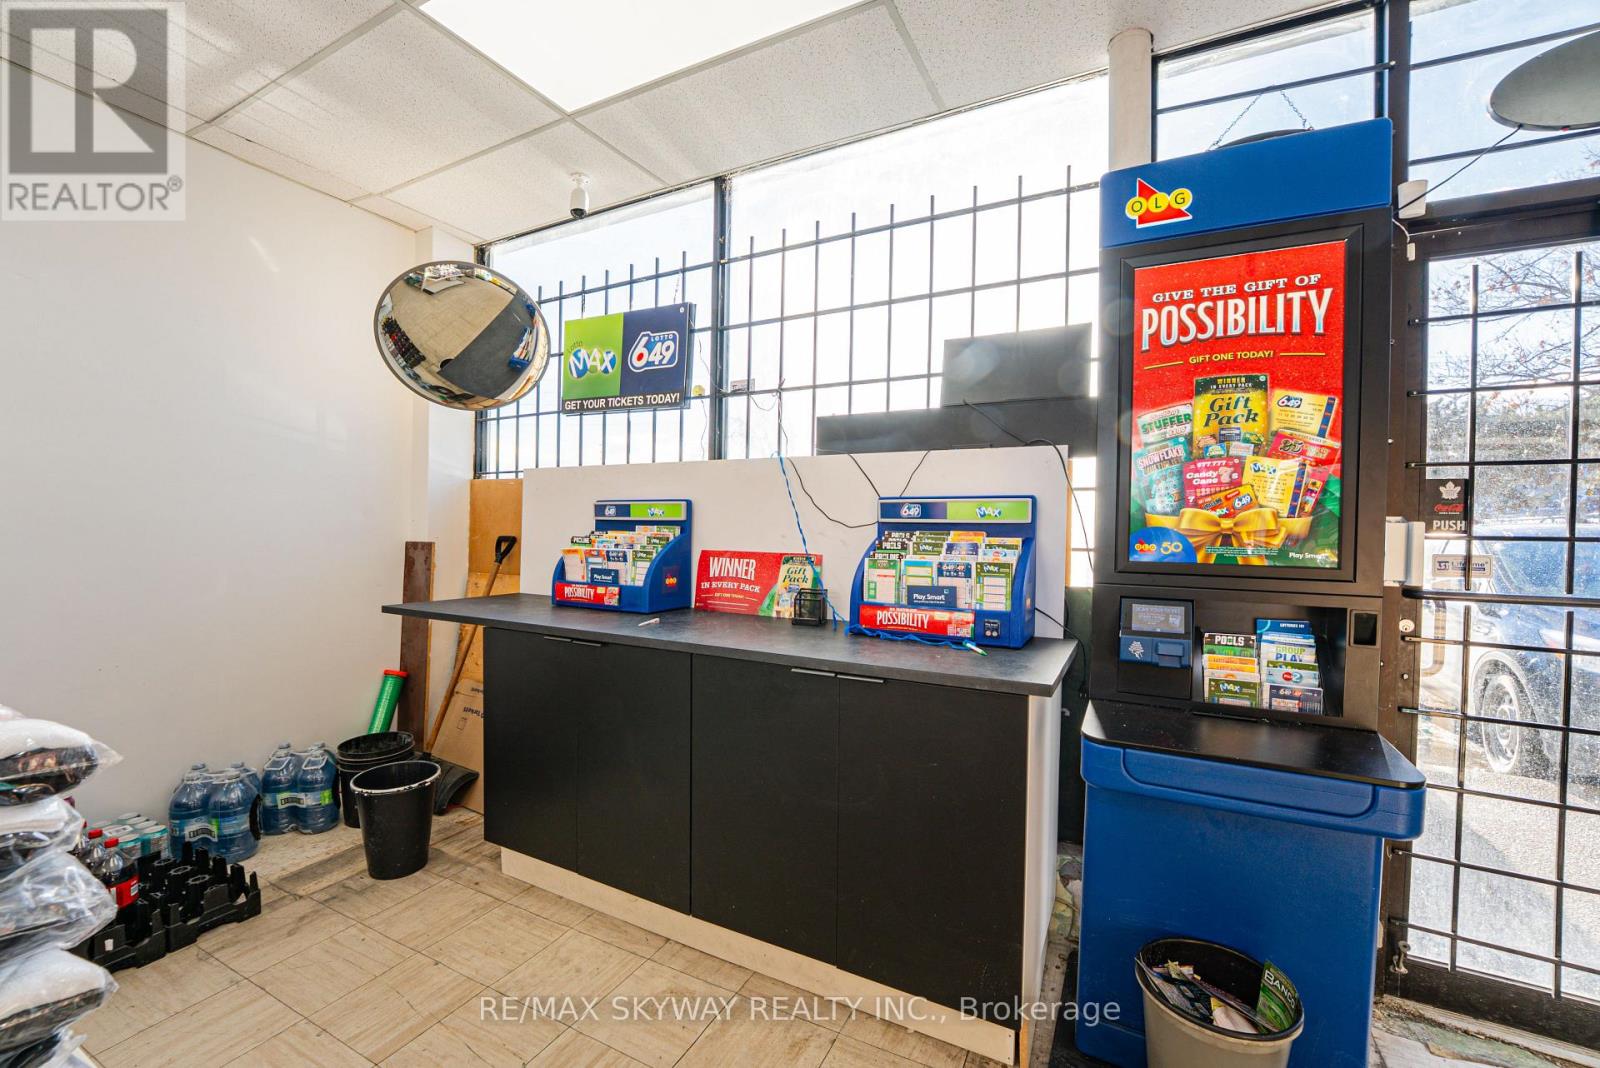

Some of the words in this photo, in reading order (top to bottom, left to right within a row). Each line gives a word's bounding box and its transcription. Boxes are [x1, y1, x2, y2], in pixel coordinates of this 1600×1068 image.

[1128, 190, 1189, 215] OLG
[1152, 289, 1194, 303] GIVE
[1201, 284, 1237, 298] THE
[1244, 278, 1288, 292] GIFT
[1295, 273, 1321, 286] OF
[1141, 288, 1334, 351] POSSIBILITY
[651, 333, 674, 342] LOTTO
[631, 336, 675, 368] 649
[1189, 355, 1210, 364] GIFT
[1212, 352, 1234, 361] ONE
[1237, 350, 1274, 359] TODAY!
[568, 348, 616, 379] MAX
[564, 401, 582, 410] GET
[582, 398, 606, 409] YOUR
[608, 395, 644, 407] TICKETS
[646, 393, 680, 404] TODAY!
[1210, 396, 1250, 412] Gift
[1141, 413, 1192, 434] STUFFER
[1204, 409, 1258, 427] Pack
[1186, 470, 1218, 479] Candy
[976, 506, 1002, 518] MAX
[1433, 520, 1466, 530] PUSH
[1161, 541, 1183, 554] 50
[709, 556, 757, 581] WINNER
[786, 567, 807, 575] Gift
[783, 574, 809, 584] Pack
[711, 581, 739, 589] EVERY
[739, 583, 761, 593] PACK
[876, 610, 930, 629] POSSIBILITY
[1215, 635, 1245, 646] POOLS
[1220, 682, 1241, 693] MAX
